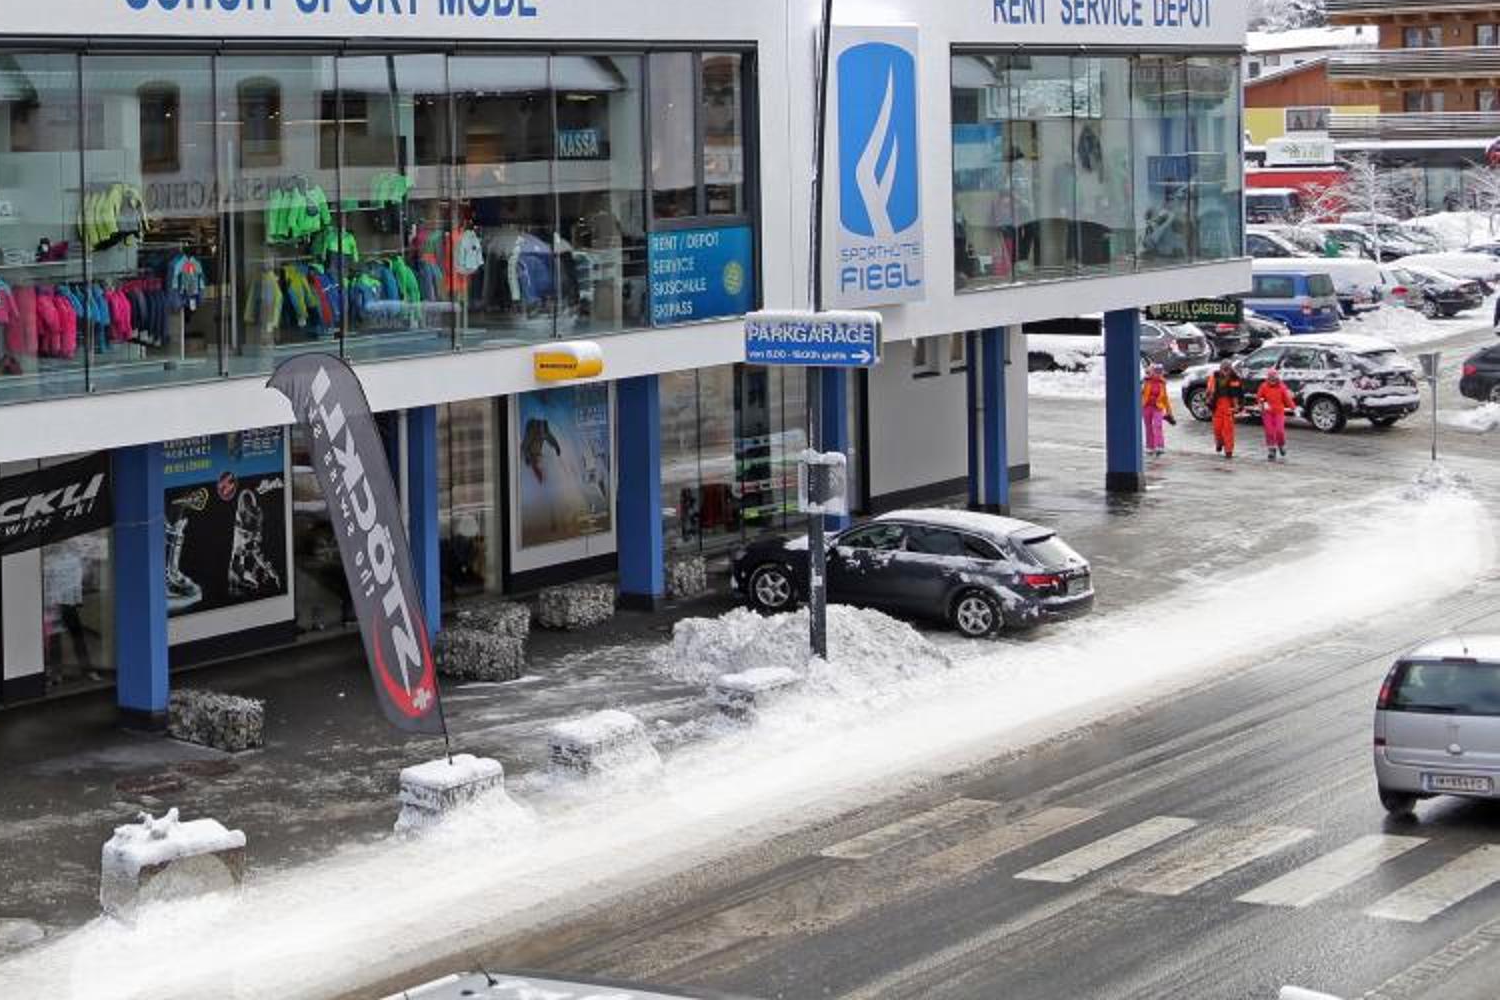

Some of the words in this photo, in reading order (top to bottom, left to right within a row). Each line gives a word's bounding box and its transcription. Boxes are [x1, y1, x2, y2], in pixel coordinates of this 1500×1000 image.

[559, 131, 599, 159] KASSA
[652, 235, 677, 251] RENT
[686, 231, 720, 249] DEPOT
[841, 262, 921, 294] FIEGL
[748, 325, 872, 343] PARKGARAGE
